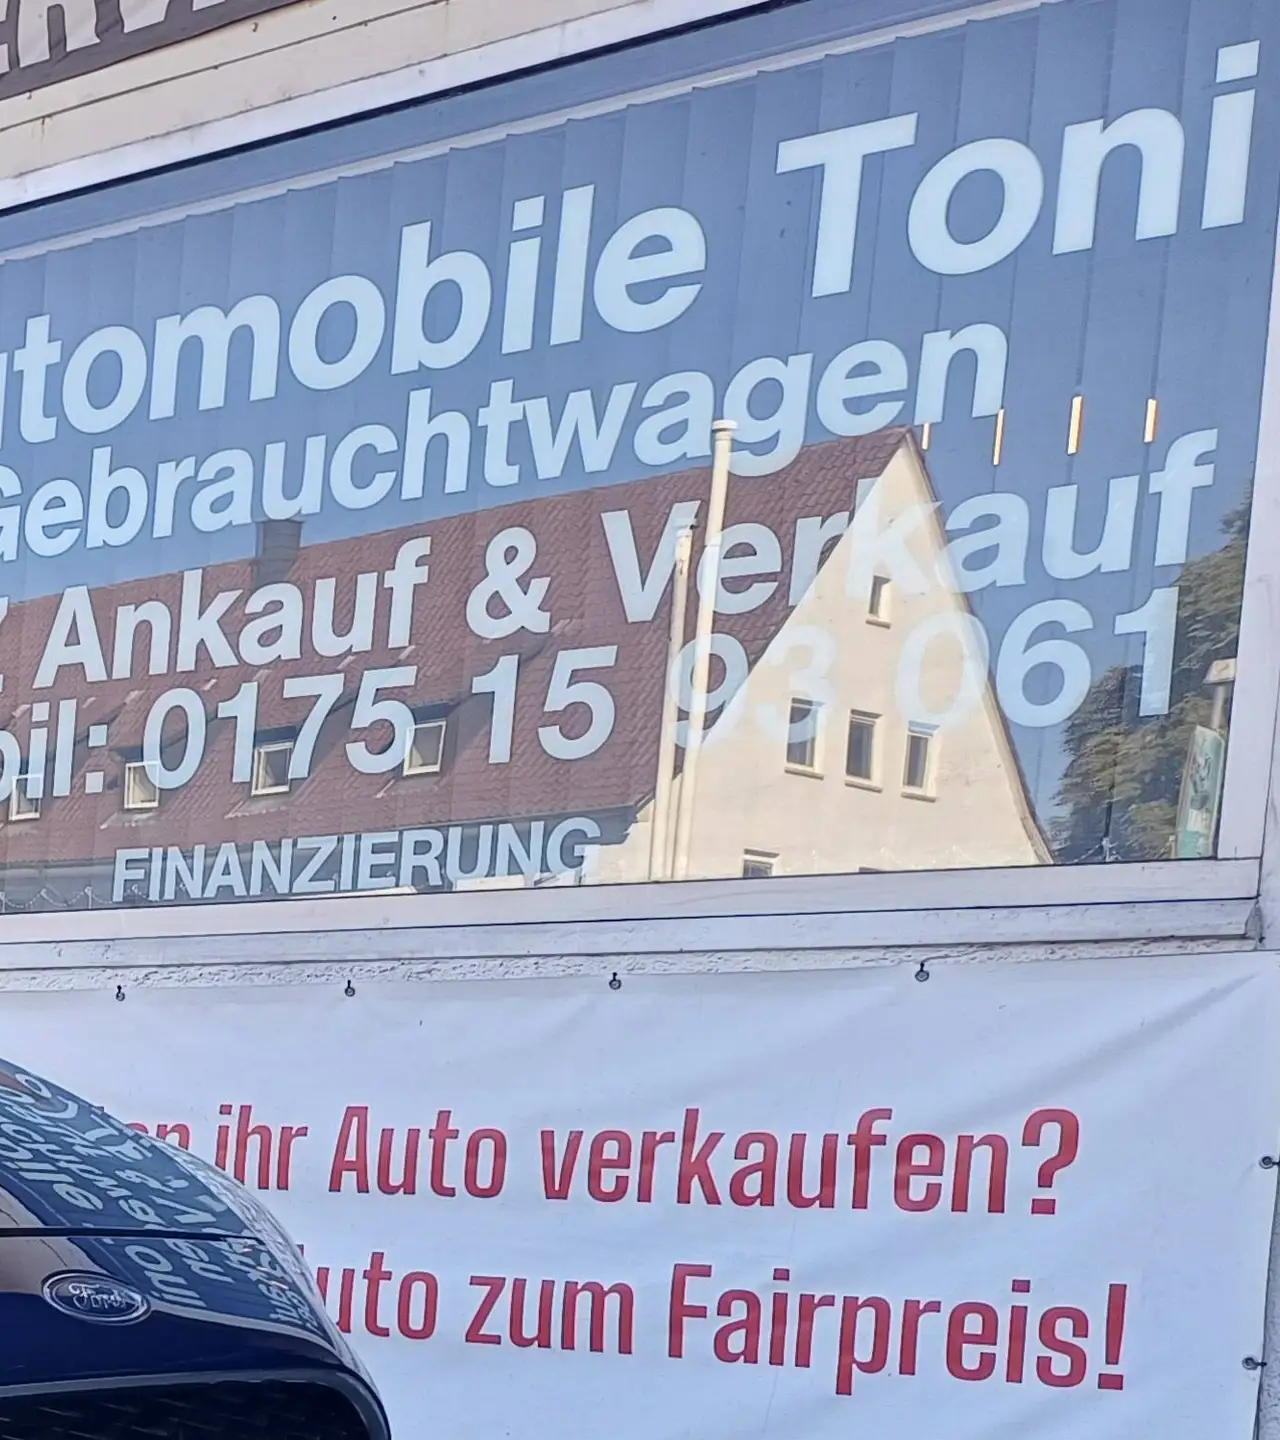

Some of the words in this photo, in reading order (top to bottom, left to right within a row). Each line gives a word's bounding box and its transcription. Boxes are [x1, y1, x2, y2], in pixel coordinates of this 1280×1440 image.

[774, 39, 1261, 299] Toni
[32, 535, 433, 690] Ankauf
[466, 526, 550, 641] &
[600, 428, 1219, 625] Verkauf
[142, 665, 418, 790] 0175
[471, 644, 618, 761] 15
[668, 624, 837, 751] 93
[892, 586, 1180, 734] 061
[112, 816, 601, 903] FINANZIERUNG
[214, 1104, 308, 1191] ihr
[328, 1106, 507, 1200] Auto
[539, 1107, 1081, 1215] verkaufen?
[297, 1244, 438, 1340] uto
[464, 1274, 635, 1356] zum
[667, 1263, 1128, 1396] Fairpreis!
